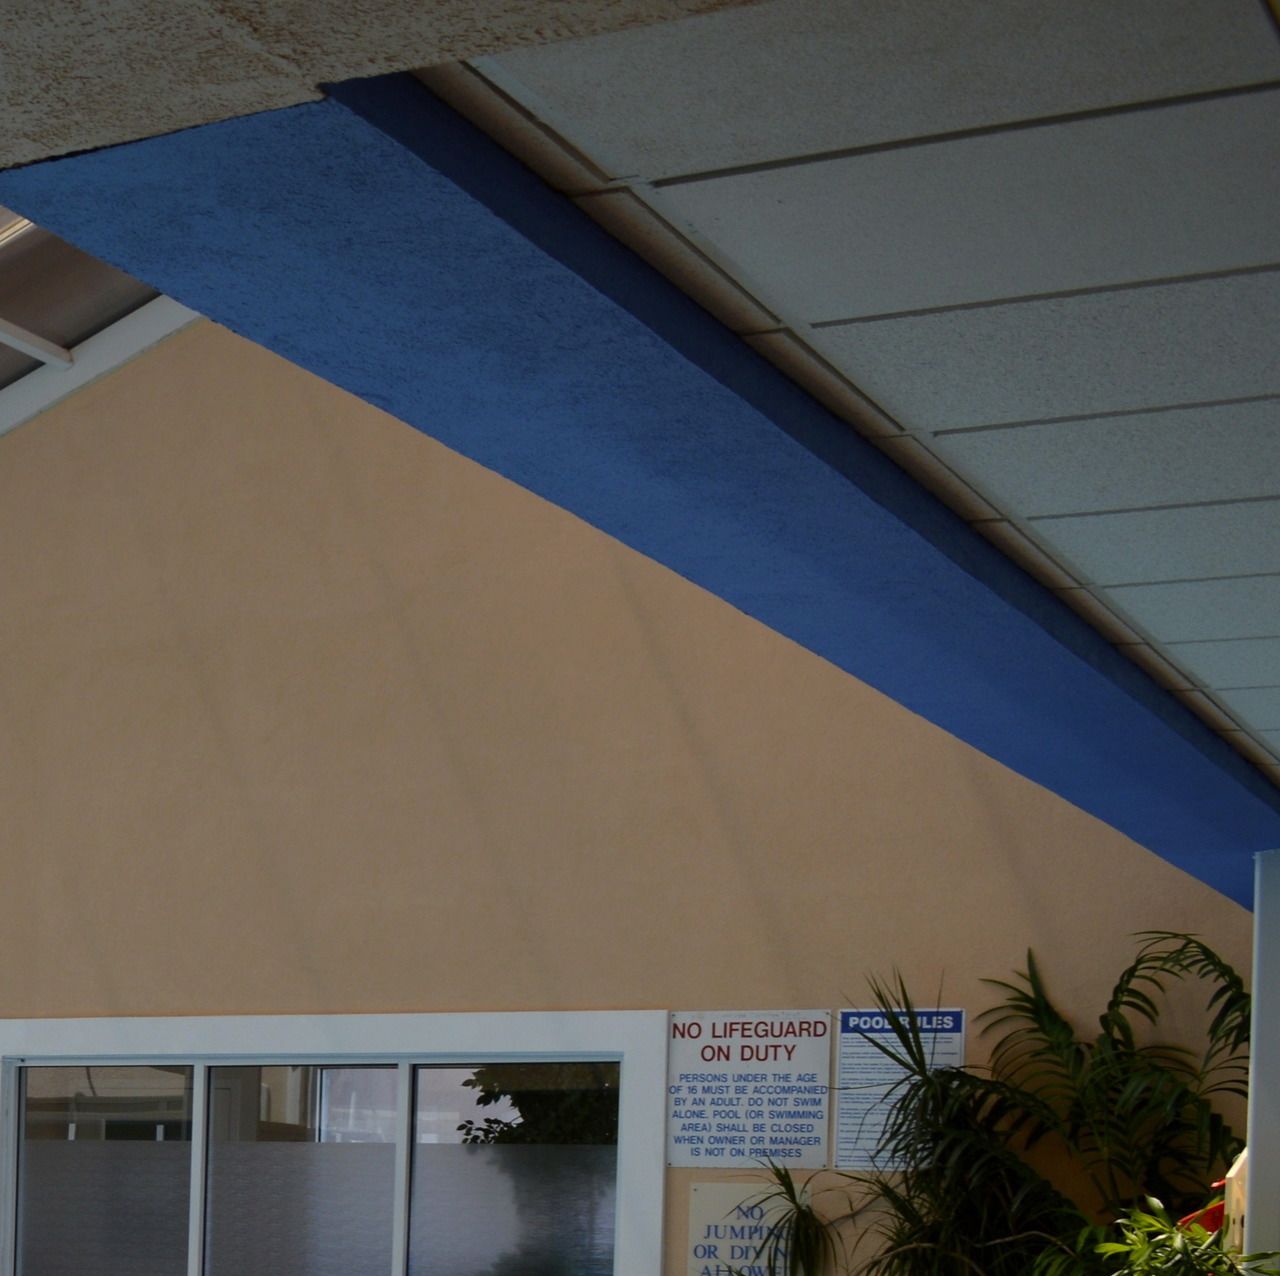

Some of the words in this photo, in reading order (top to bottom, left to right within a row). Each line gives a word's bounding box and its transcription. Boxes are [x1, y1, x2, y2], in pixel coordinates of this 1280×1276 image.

[899, 1015, 954, 1029] RLES
[672, 1022, 702, 1039] NO
[711, 1021, 827, 1038] LIFEGUARD
[700, 1045, 730, 1062] ON
[740, 1045, 797, 1061] DUTY
[679, 1073, 728, 1083] PERSONS
[732, 1073, 767, 1083] UNDER
[772, 1073, 791, 1082] THE
[796, 1073, 818, 1083] AGE
[668, 1085, 683, 1095] OF
[687, 1085, 698, 1095] 16
[702, 1085, 730, 1095] MUST
[734, 1085, 749, 1095] BE
[752, 1085, 828, 1095] ACCOMPANIED
[674, 1097, 687, 1107] BY
[691, 1097, 705, 1107] AN
[709, 1097, 744, 1107] ADULT.
[748, 1097, 764, 1107] DO
[767, 1097, 789, 1107] NOT
[793, 1097, 822, 1107] SWIM
[712, 1110, 742, 1120] POOL
[745, 1110, 764, 1121] (OR
[768, 1110, 824, 1120] SWIMMING
[680, 1123, 712, 1133] AREA)
[715, 1123, 749, 1133] SHALL
[752, 1123, 766, 1133] BE
[770, 1123, 814, 1133] CLOSED
[673, 1135, 704, 1145] WHEN
[707, 1135, 746, 1145] OWNER
[750, 1135, 766, 1145] OR
[769, 1136, 821, 1145] MANAGER
[690, 1147, 701, 1157] IS
[704, 1147, 726, 1157] NOT
[729, 1147, 745, 1157] ON
[749, 1148, 802, 1158] PREMISES
[736, 1204, 764, 1221] NO
[693, 1244, 719, 1260] OR
